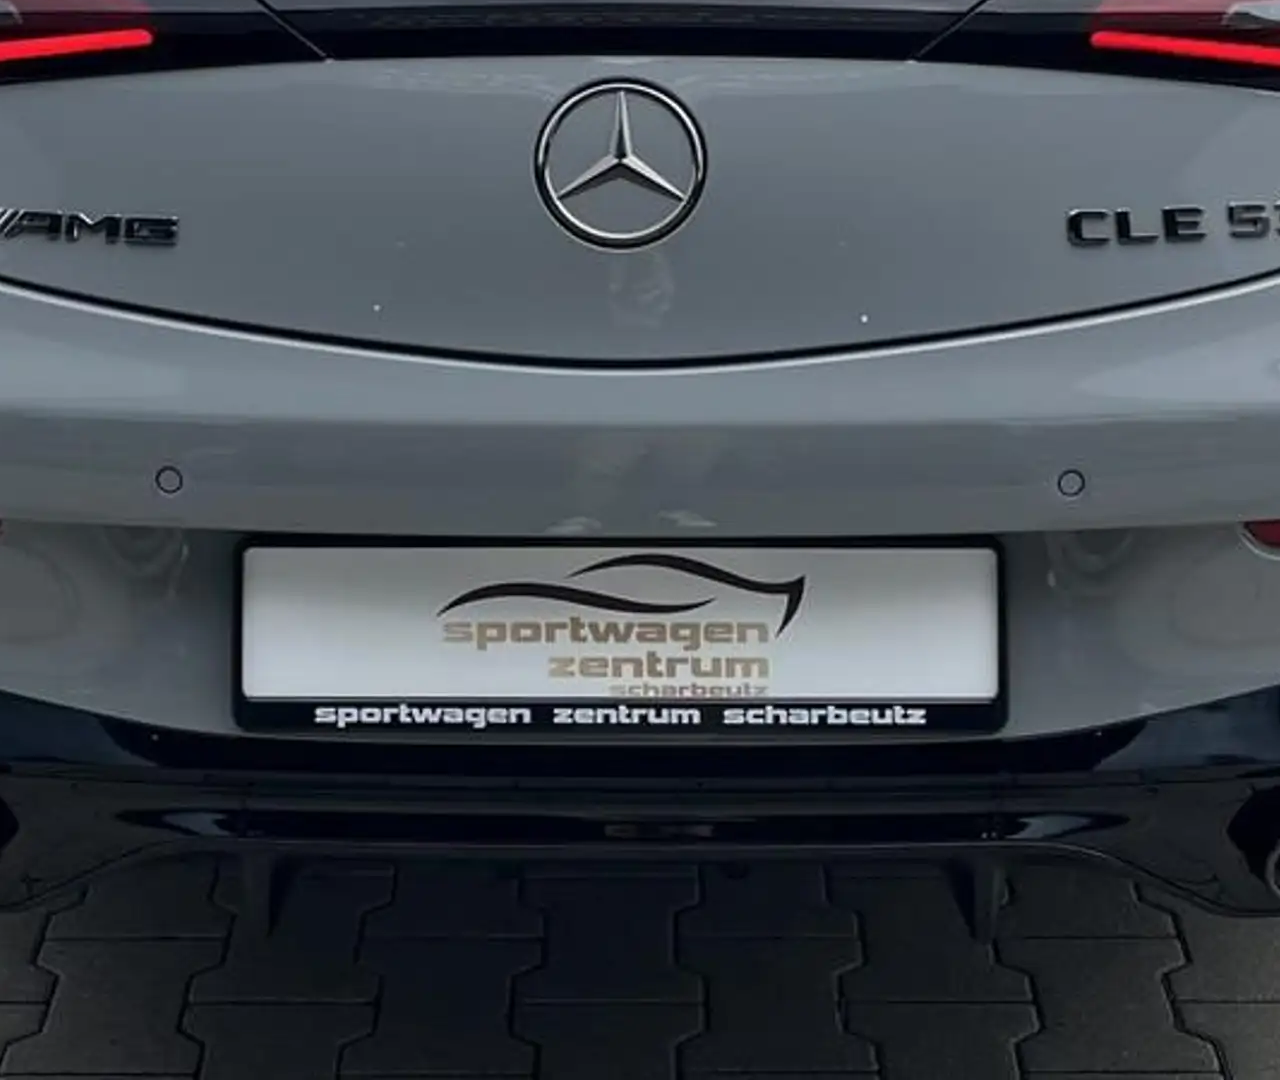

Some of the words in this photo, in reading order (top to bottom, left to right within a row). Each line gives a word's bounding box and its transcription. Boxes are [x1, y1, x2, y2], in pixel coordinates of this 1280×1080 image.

[5, 208, 178, 245] AMG
[1066, 205, 1207, 247] CLE
[443, 617, 769, 650] sportwagen
[548, 651, 769, 678] zentrum
[609, 680, 768, 698] scharbeutz
[314, 704, 532, 729] sportwagen
[553, 705, 702, 724] zentrum
[723, 705, 927, 724] scharbeutz
